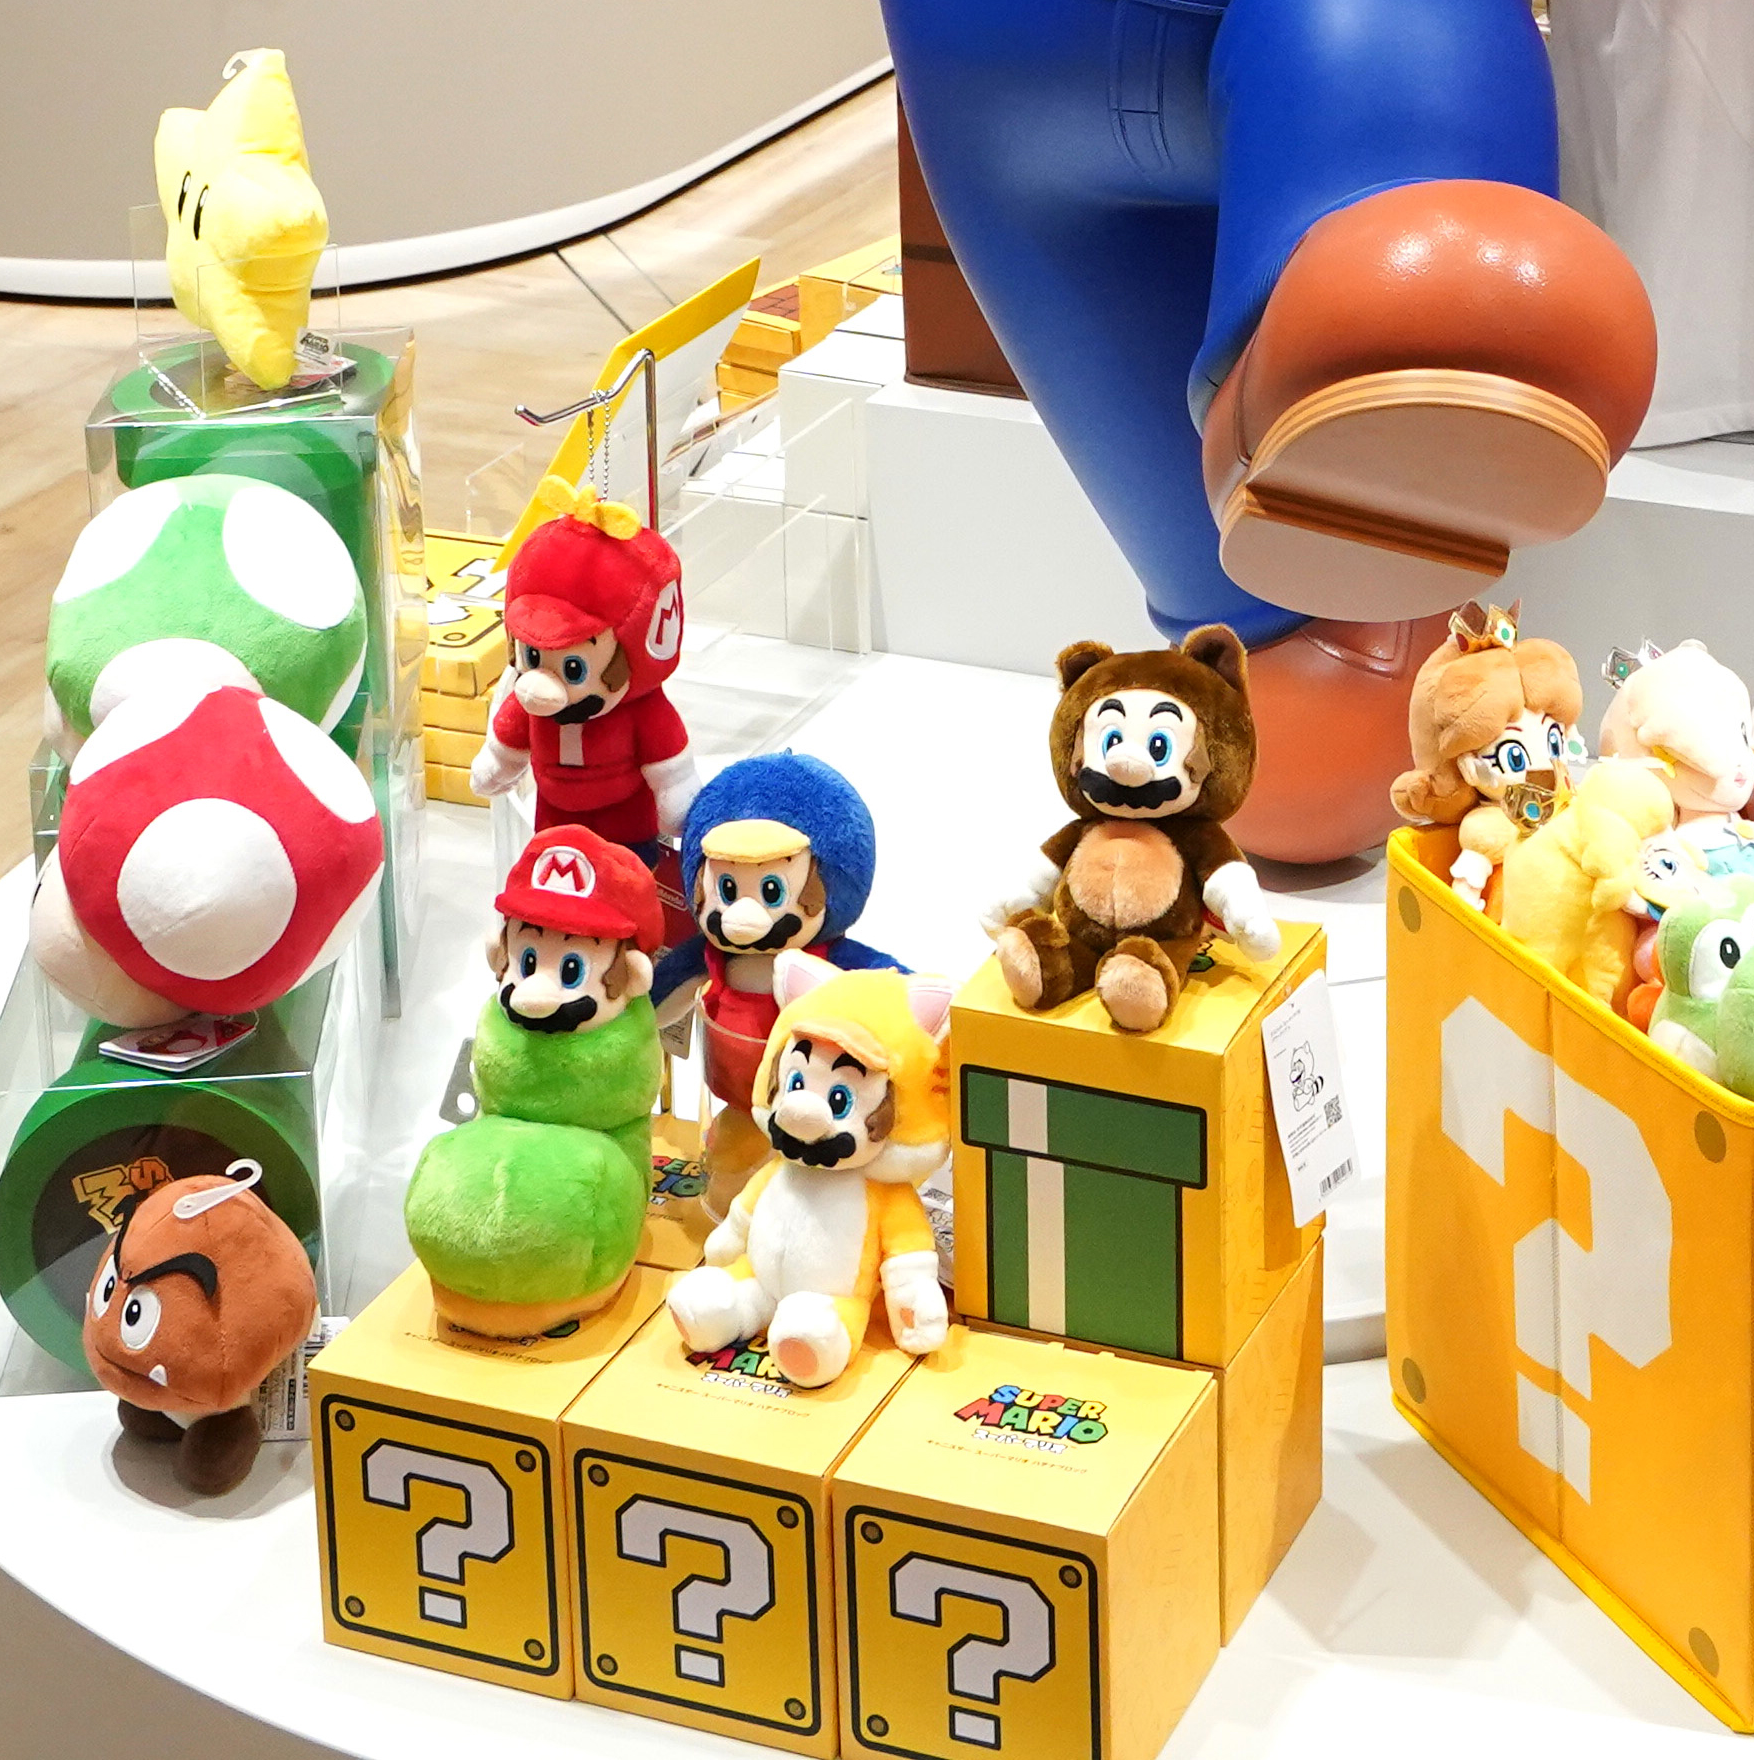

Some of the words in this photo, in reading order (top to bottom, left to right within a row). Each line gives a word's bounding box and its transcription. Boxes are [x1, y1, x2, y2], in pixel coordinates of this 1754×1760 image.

[537, 853, 586, 893] M
[952, 1397, 1109, 1445] MARIO
[989, 1384, 1108, 1421] SUPER
